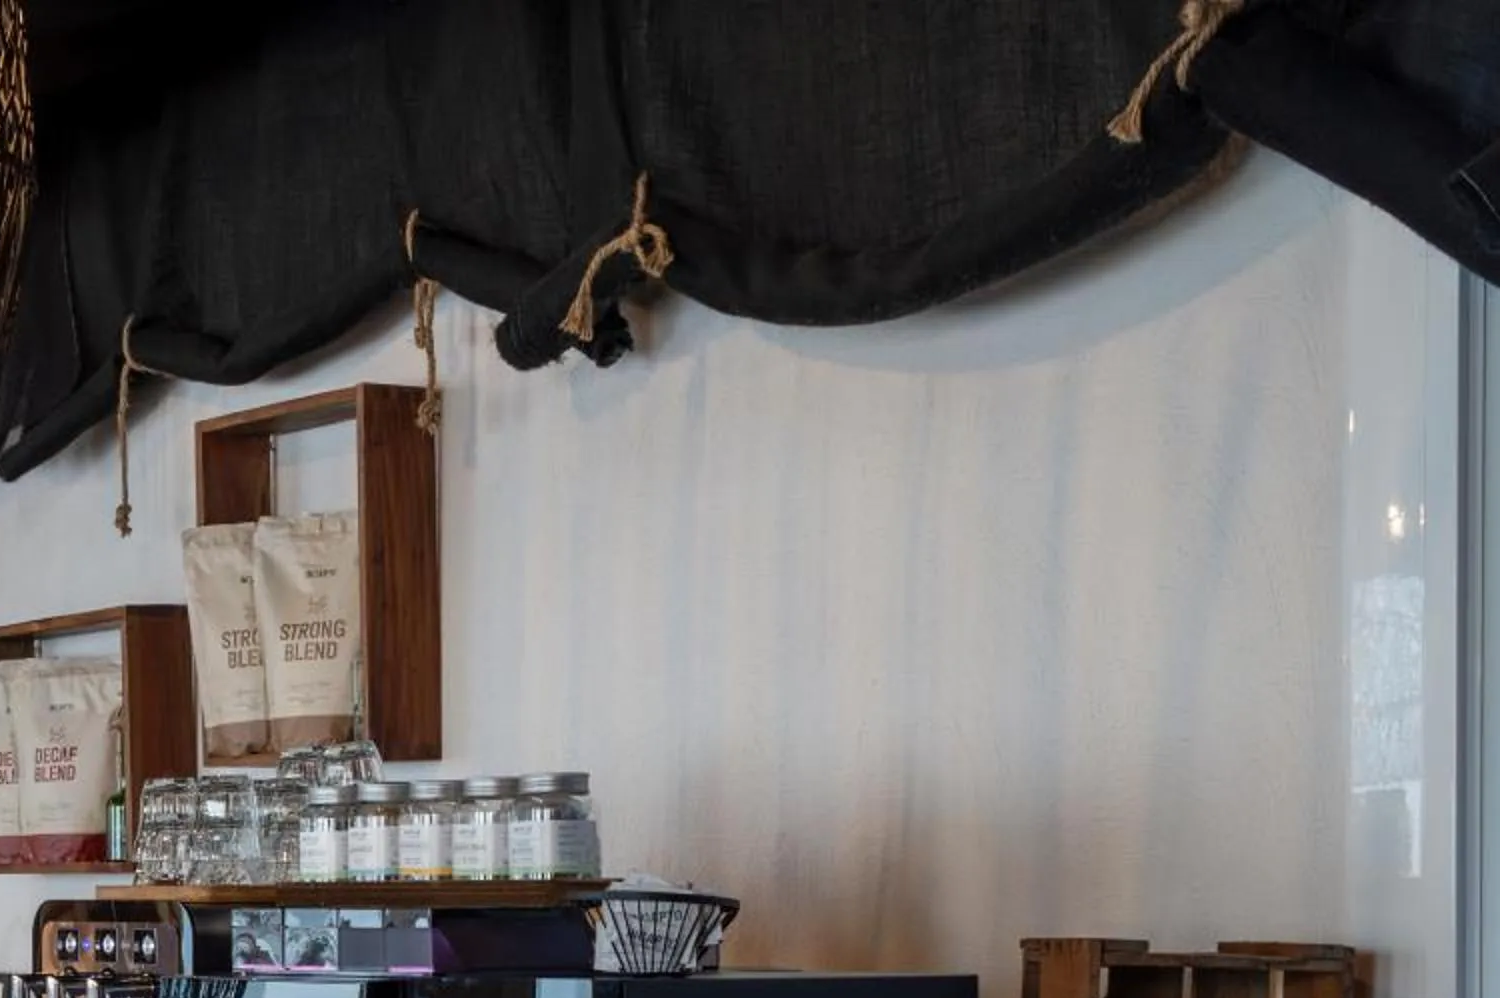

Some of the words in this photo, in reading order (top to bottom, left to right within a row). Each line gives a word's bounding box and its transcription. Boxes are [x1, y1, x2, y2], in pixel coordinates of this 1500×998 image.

[221, 628, 259, 649] STRO
[279, 618, 346, 641] STRONG
[227, 650, 263, 669] BLE
[284, 641, 338, 662] BLEND
[35, 746, 78, 764] DECAF
[34, 765, 77, 782] BLEND
